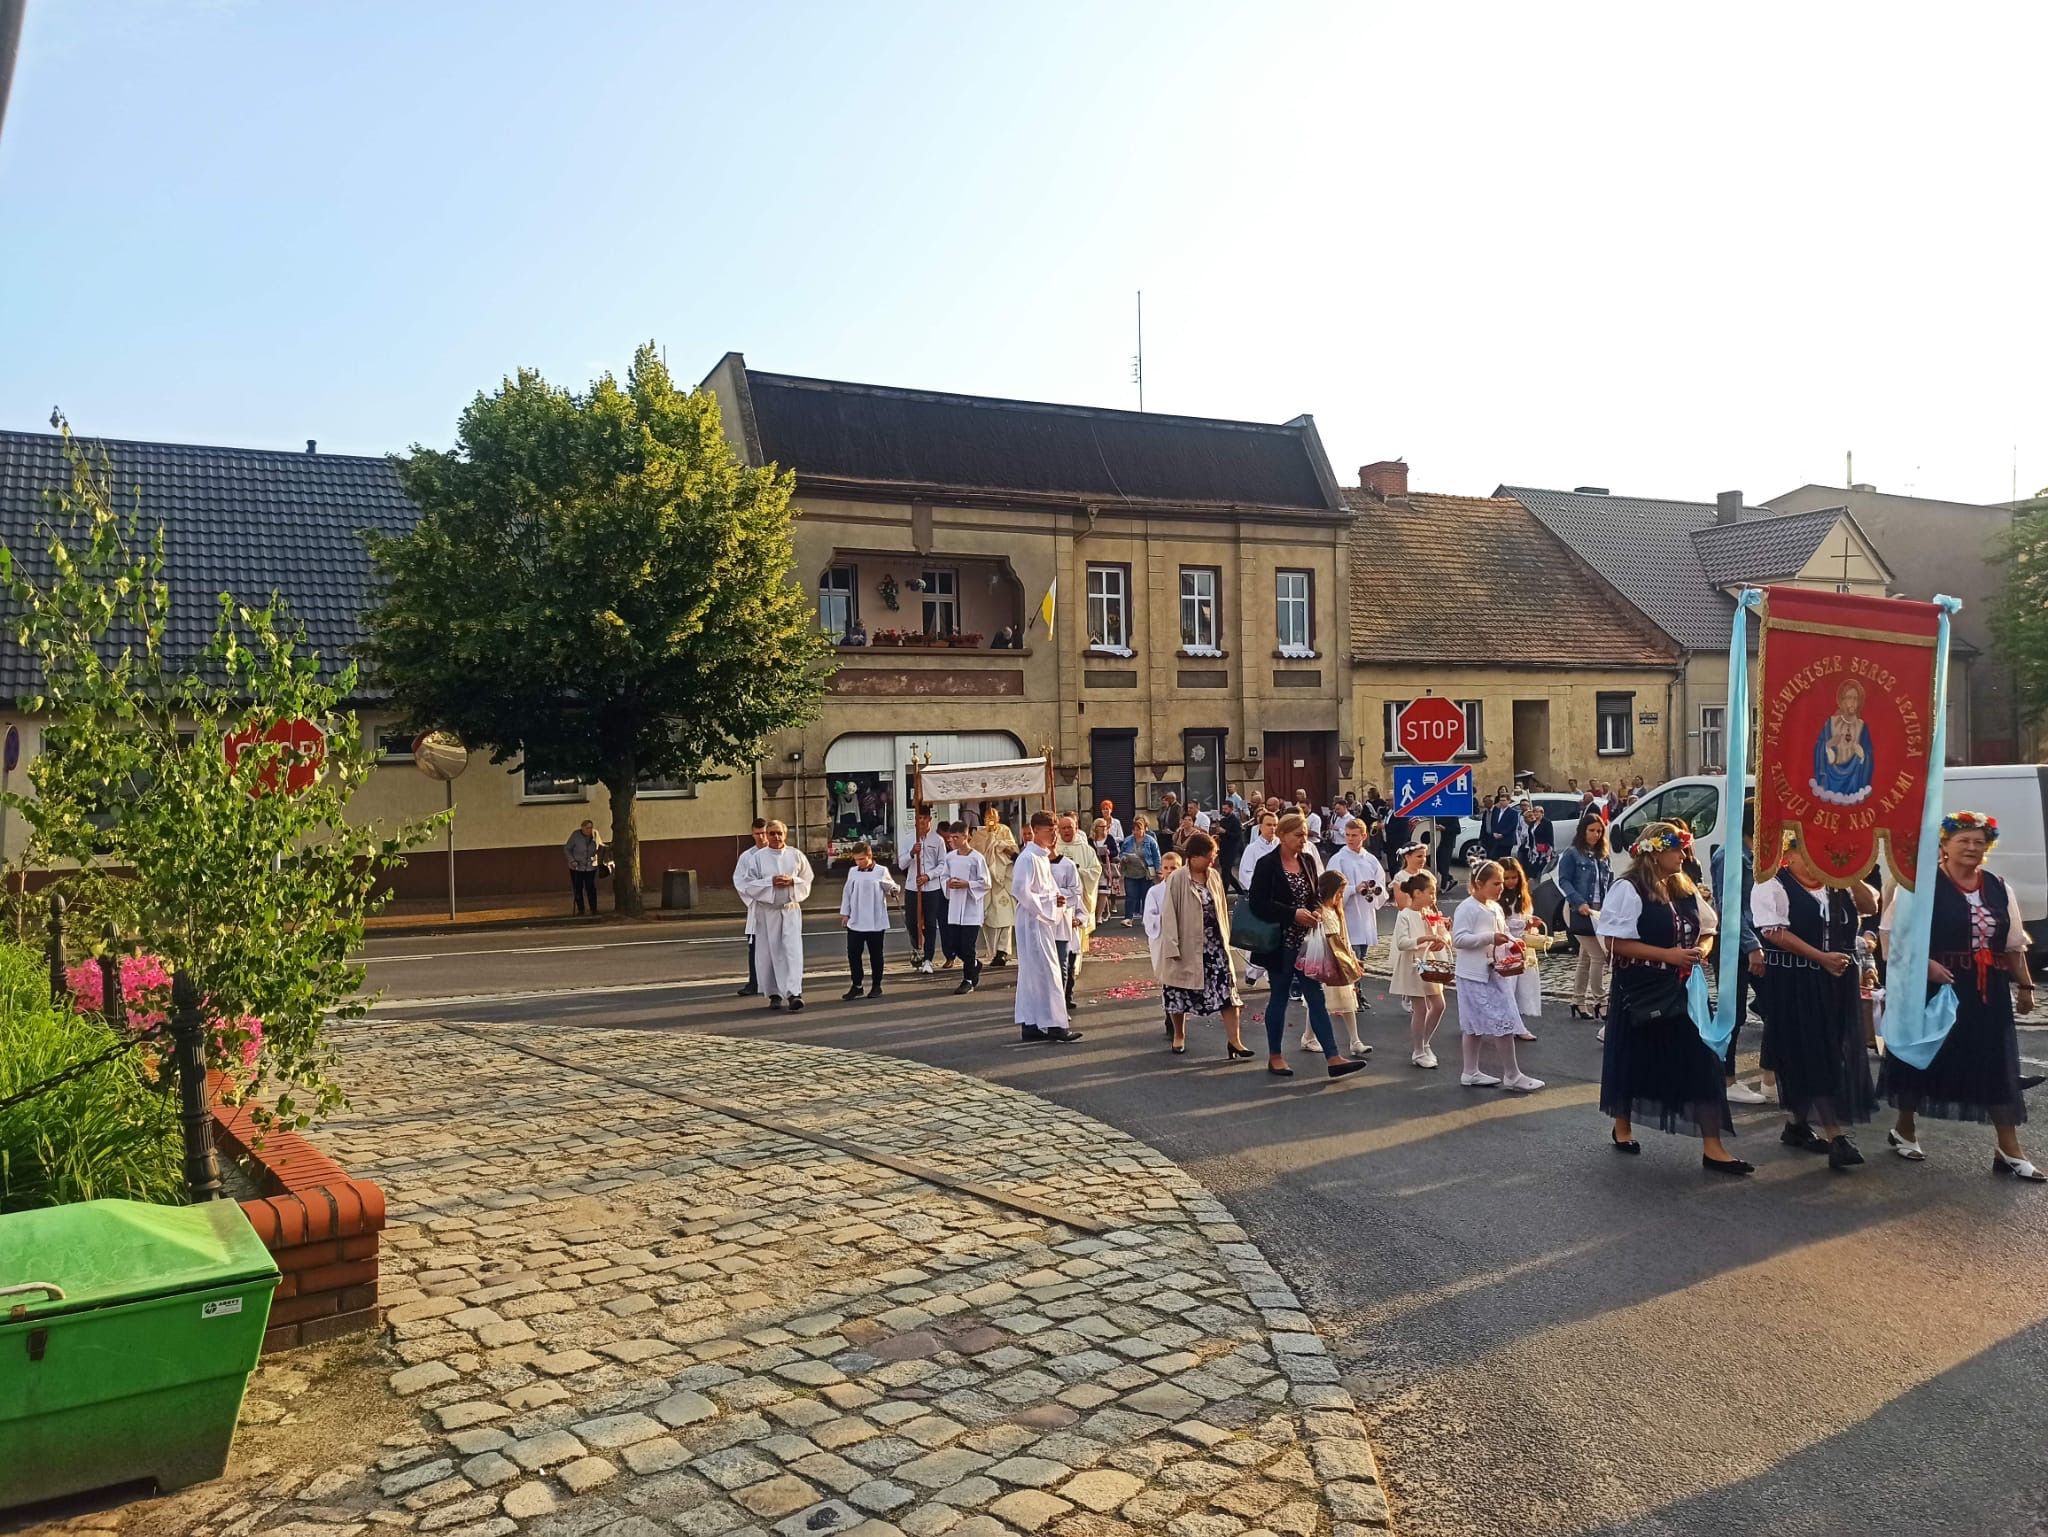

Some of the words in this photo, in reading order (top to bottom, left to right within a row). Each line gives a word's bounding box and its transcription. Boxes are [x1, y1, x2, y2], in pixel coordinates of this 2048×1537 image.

[1406, 719, 1459, 740] STOP
[1767, 655, 1842, 745] NAJŚWIĘTSZE
[1850, 656, 1897, 693] SERCE
[1895, 693, 1923, 760] JEZUSA
[235, 741, 317, 767] OP
[1813, 808, 1840, 835] SIĘ
[1849, 807, 1876, 831] NAD
[1879, 769, 1915, 813] NAMI
